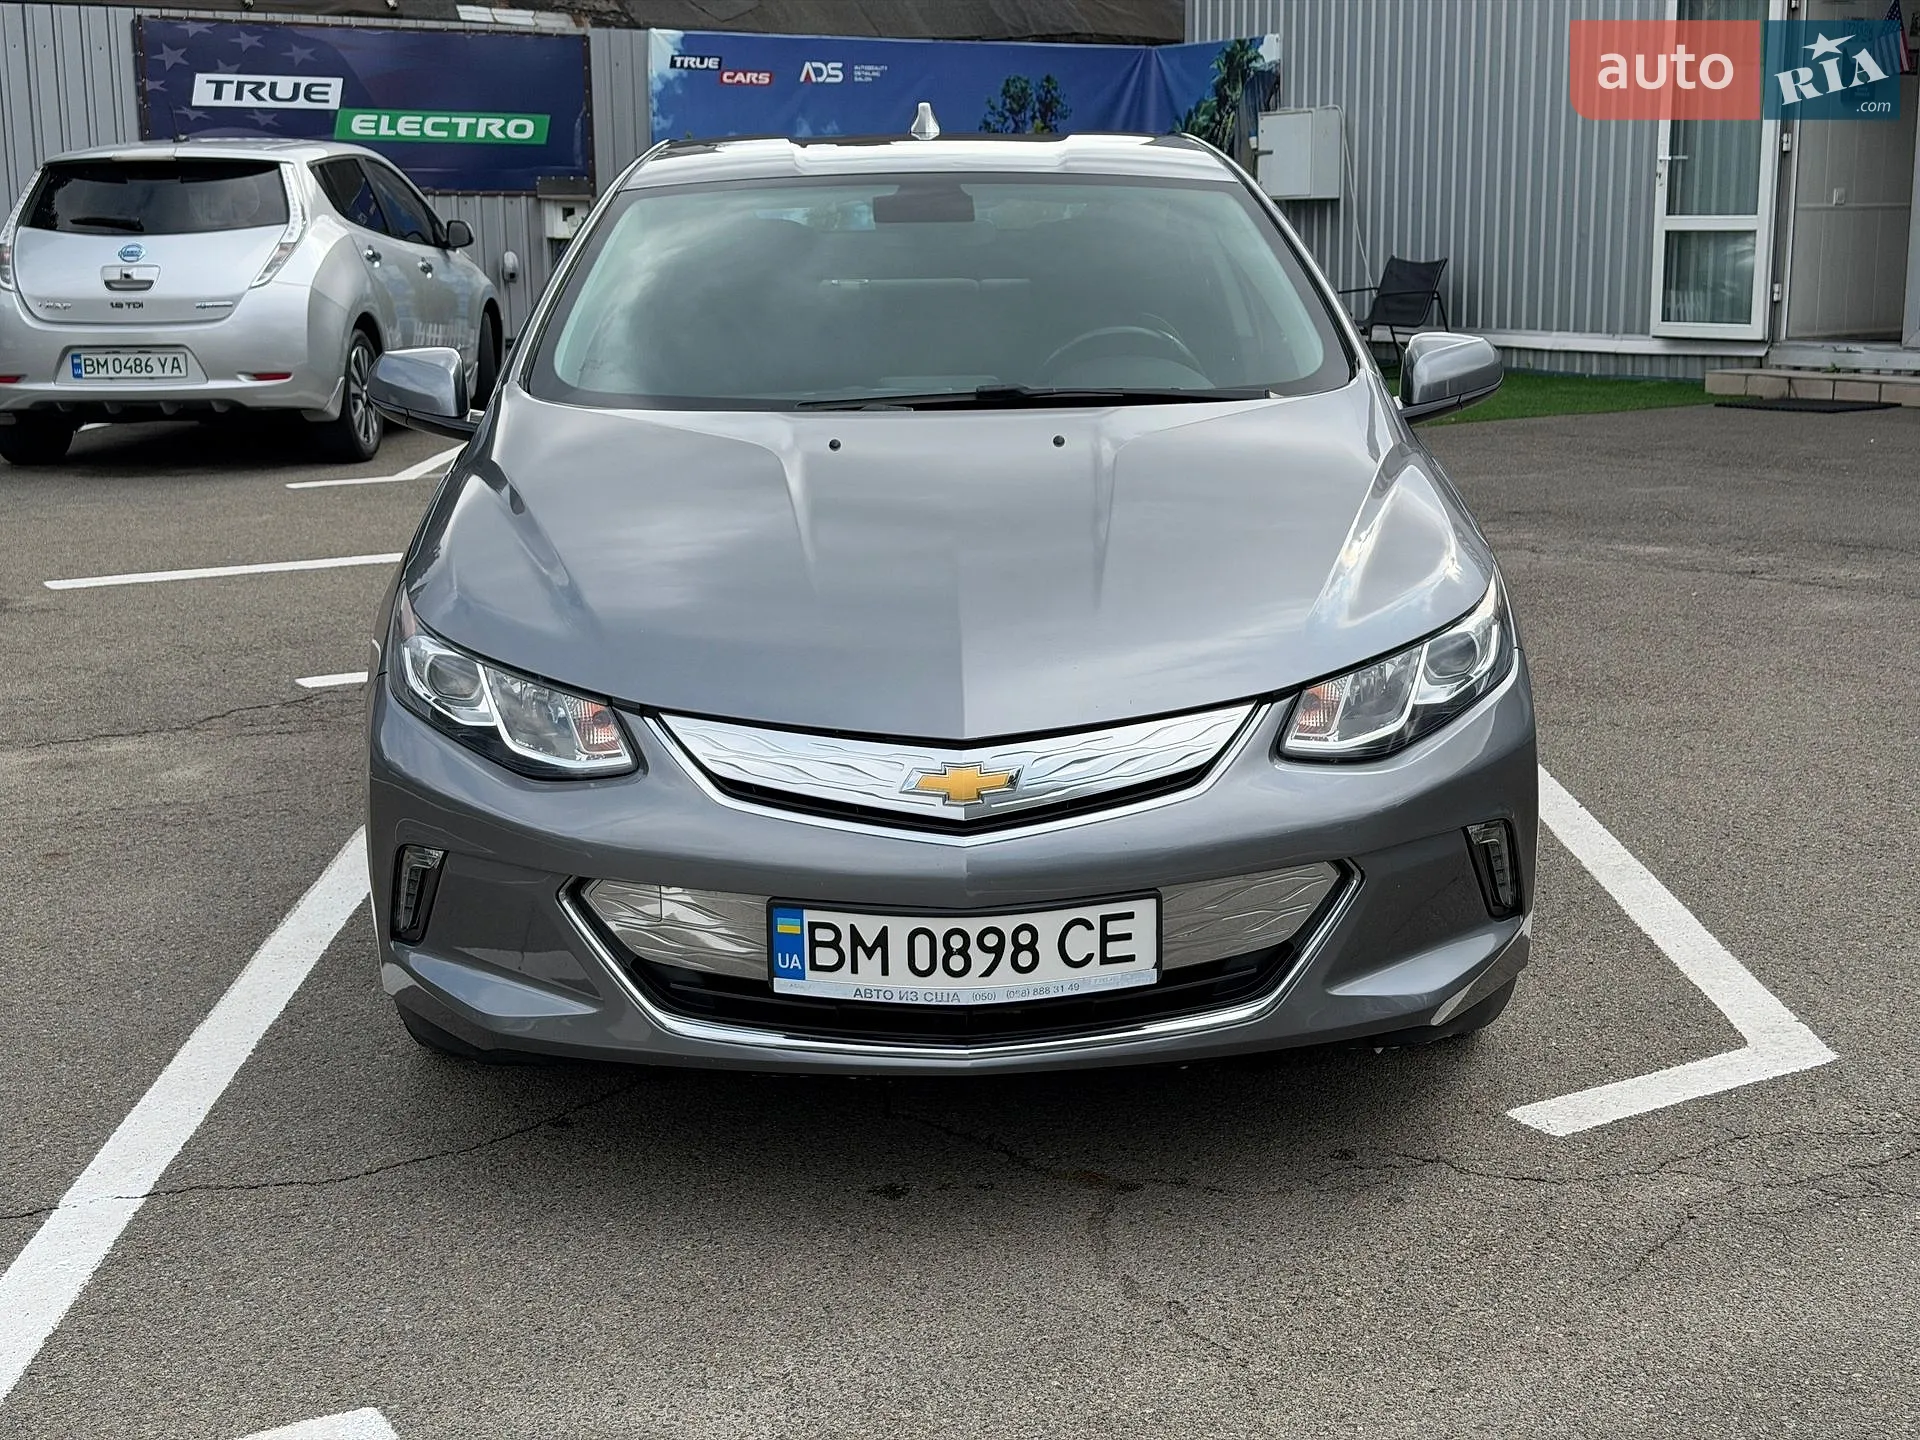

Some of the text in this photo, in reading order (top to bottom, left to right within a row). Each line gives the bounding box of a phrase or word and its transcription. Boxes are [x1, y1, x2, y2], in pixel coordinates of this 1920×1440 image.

[673, 56, 721, 70] TRUE
[800, 61, 844, 84] ADS
[722, 71, 771, 85] CARS
[205, 79, 332, 105] TRUE
[350, 112, 536, 140] ELECTRO
[84, 356, 183, 375] BM 0486 YA
[806, 910, 1137, 978] BM 0898 CE
[777, 951, 802, 970] UA
[853, 987, 894, 1001] АВТО
[898, 990, 919, 1002] ИЗ
[923, 991, 961, 1003] США
[1032, 985, 1051, 996] 888
[1053, 985, 1065, 994] 31
[1067, 983, 1080, 992] 49
